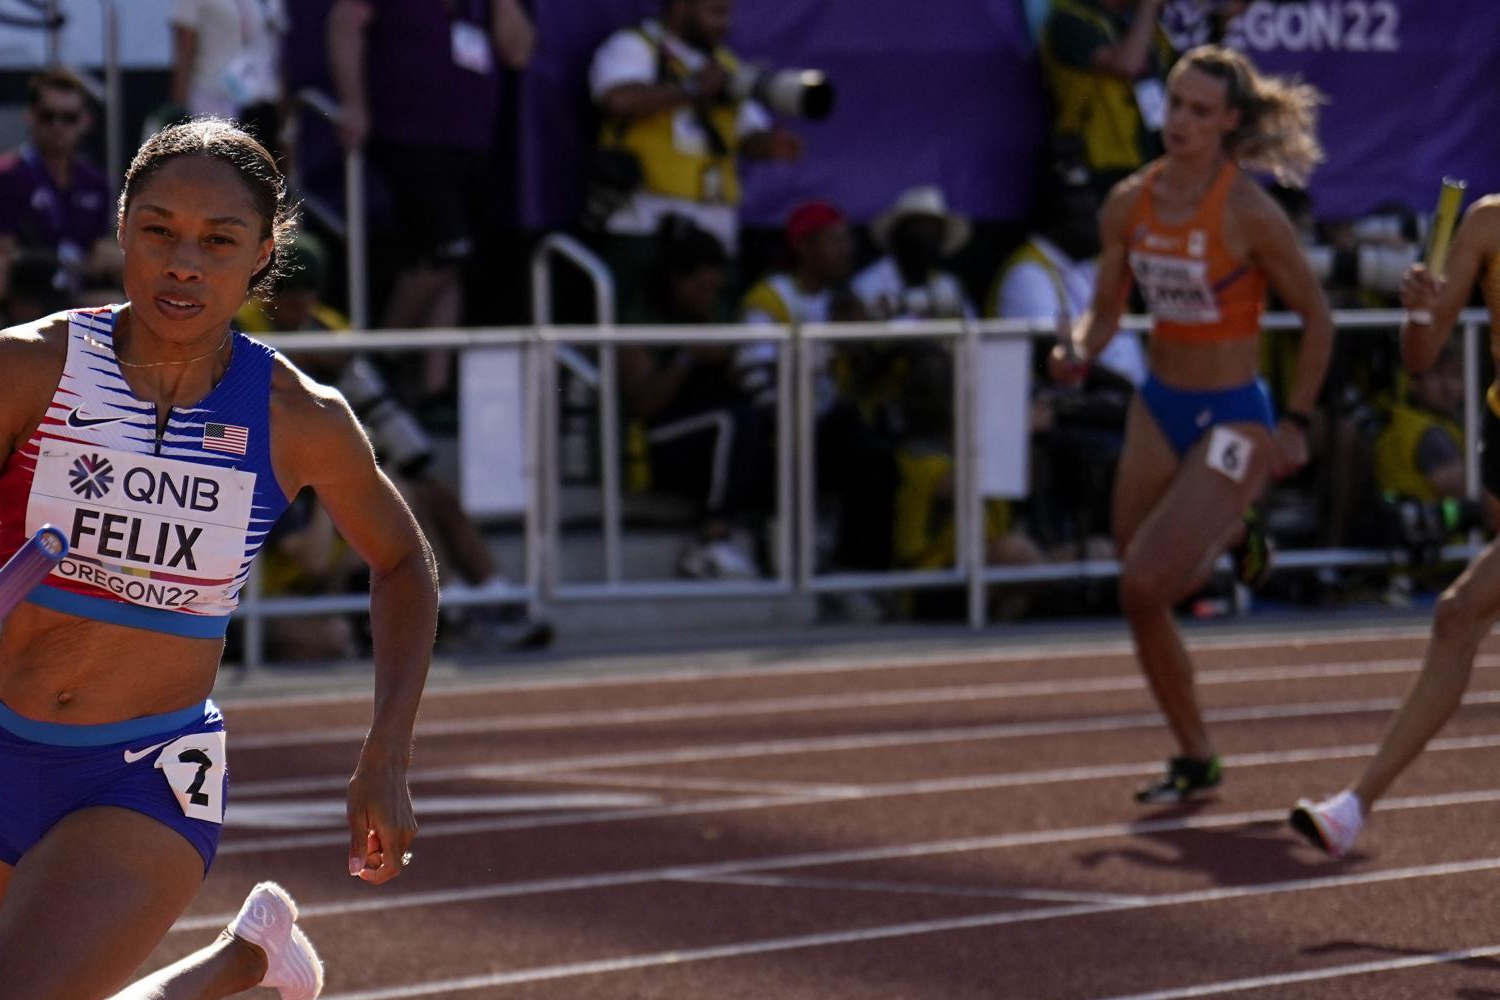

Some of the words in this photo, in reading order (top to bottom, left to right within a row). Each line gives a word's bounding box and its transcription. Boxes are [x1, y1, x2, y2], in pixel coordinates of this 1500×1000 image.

[1222, 440, 1241, 470] 6
[123, 467, 220, 512] QNB
[70, 508, 203, 571] FELIX
[58, 560, 200, 607] OREGON22
[177, 748, 213, 808] 2
